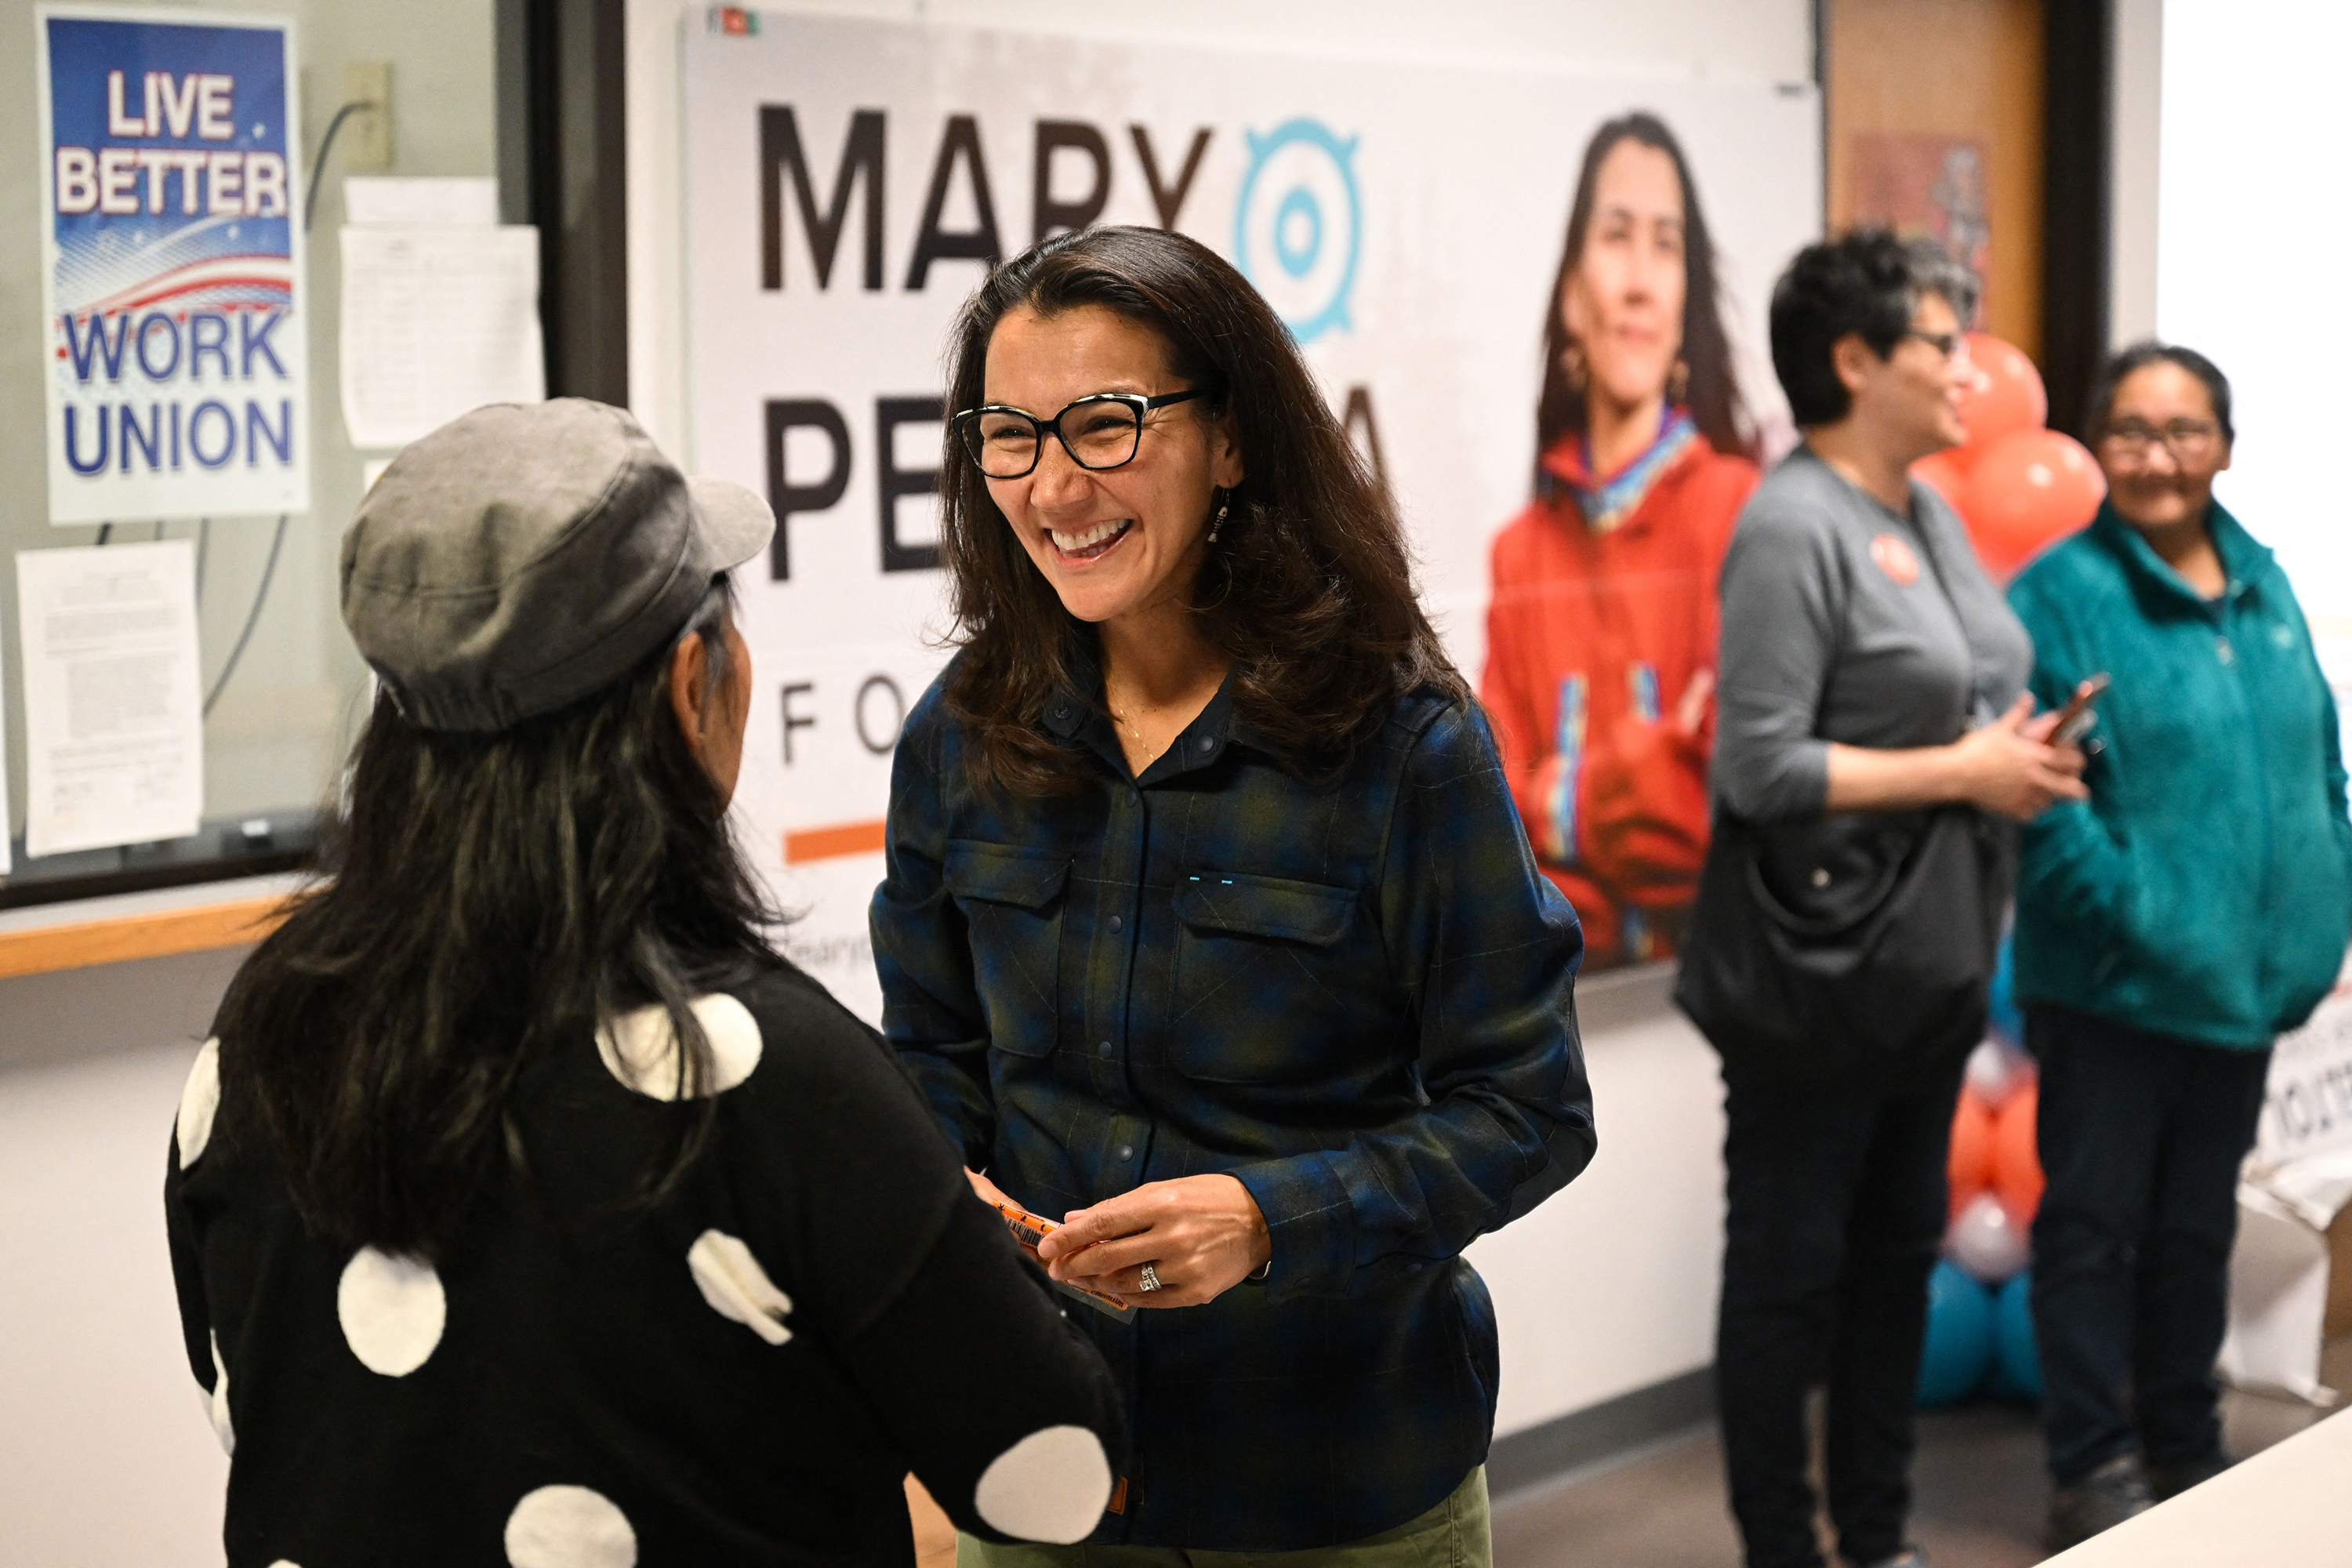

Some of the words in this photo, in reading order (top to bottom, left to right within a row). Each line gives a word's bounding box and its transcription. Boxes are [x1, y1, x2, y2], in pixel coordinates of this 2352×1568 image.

[107, 71, 234, 138] LIVE
[56, 147, 288, 217] BETTER
[757, 103, 1215, 292] MARY
[64, 311, 288, 383] WORK
[64, 398, 292, 476] UNION
[780, 673, 906, 765] FO
